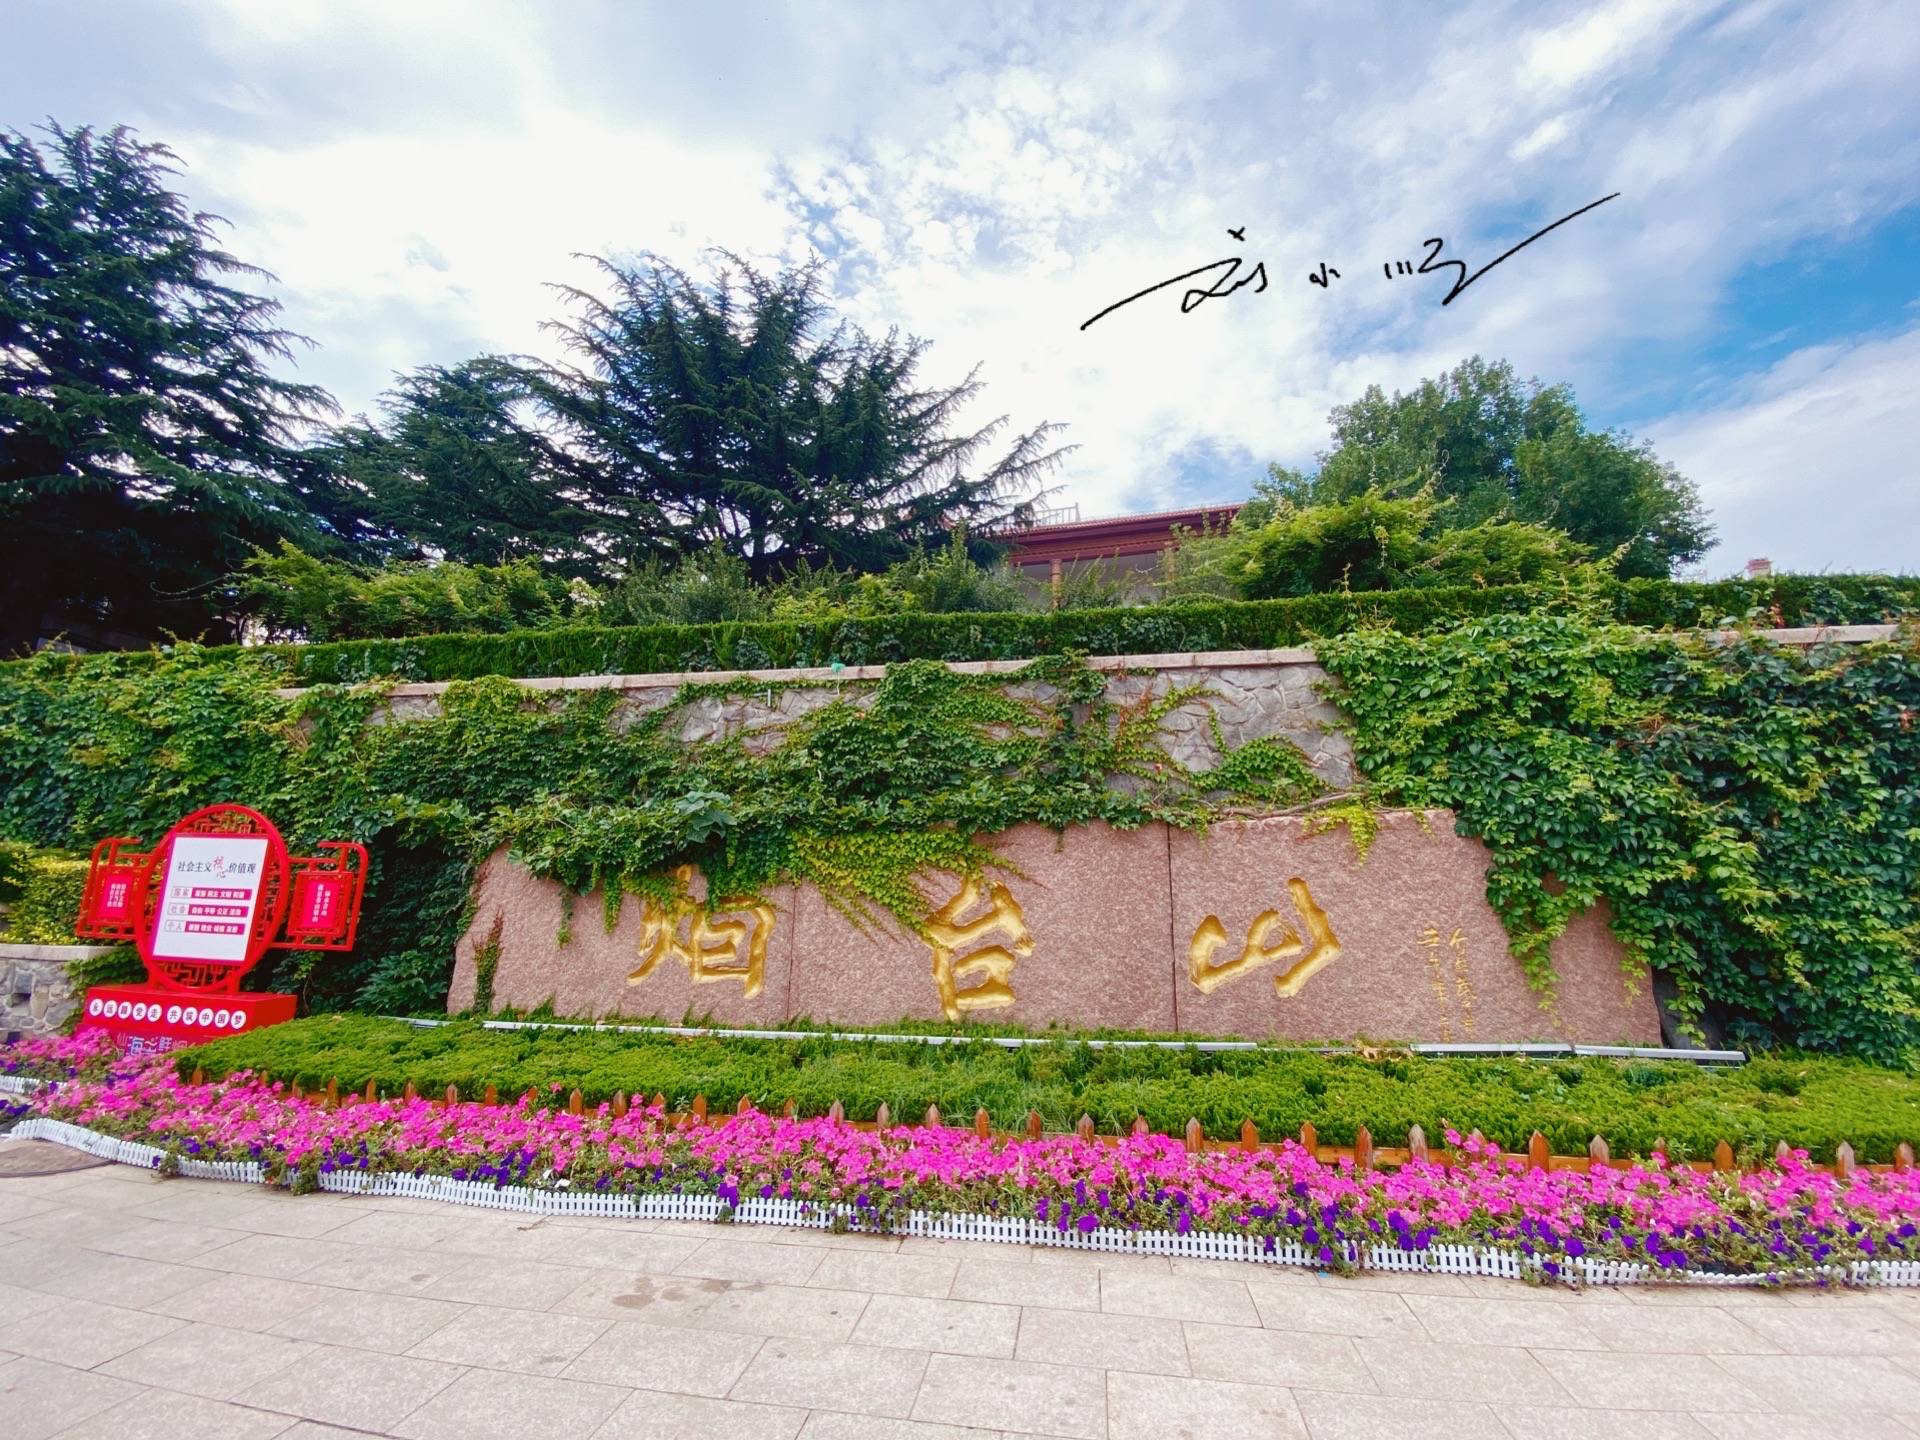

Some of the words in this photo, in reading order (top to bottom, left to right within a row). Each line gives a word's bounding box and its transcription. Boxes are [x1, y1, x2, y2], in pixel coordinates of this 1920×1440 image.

[177, 856, 257, 879] 社会主义核心价值观
[626, 864, 1342, 1021] 烟台山
[91, 1001, 159, 1019] 永远跟党走
[169, 1008, 244, 1027] 共筑中国梦
